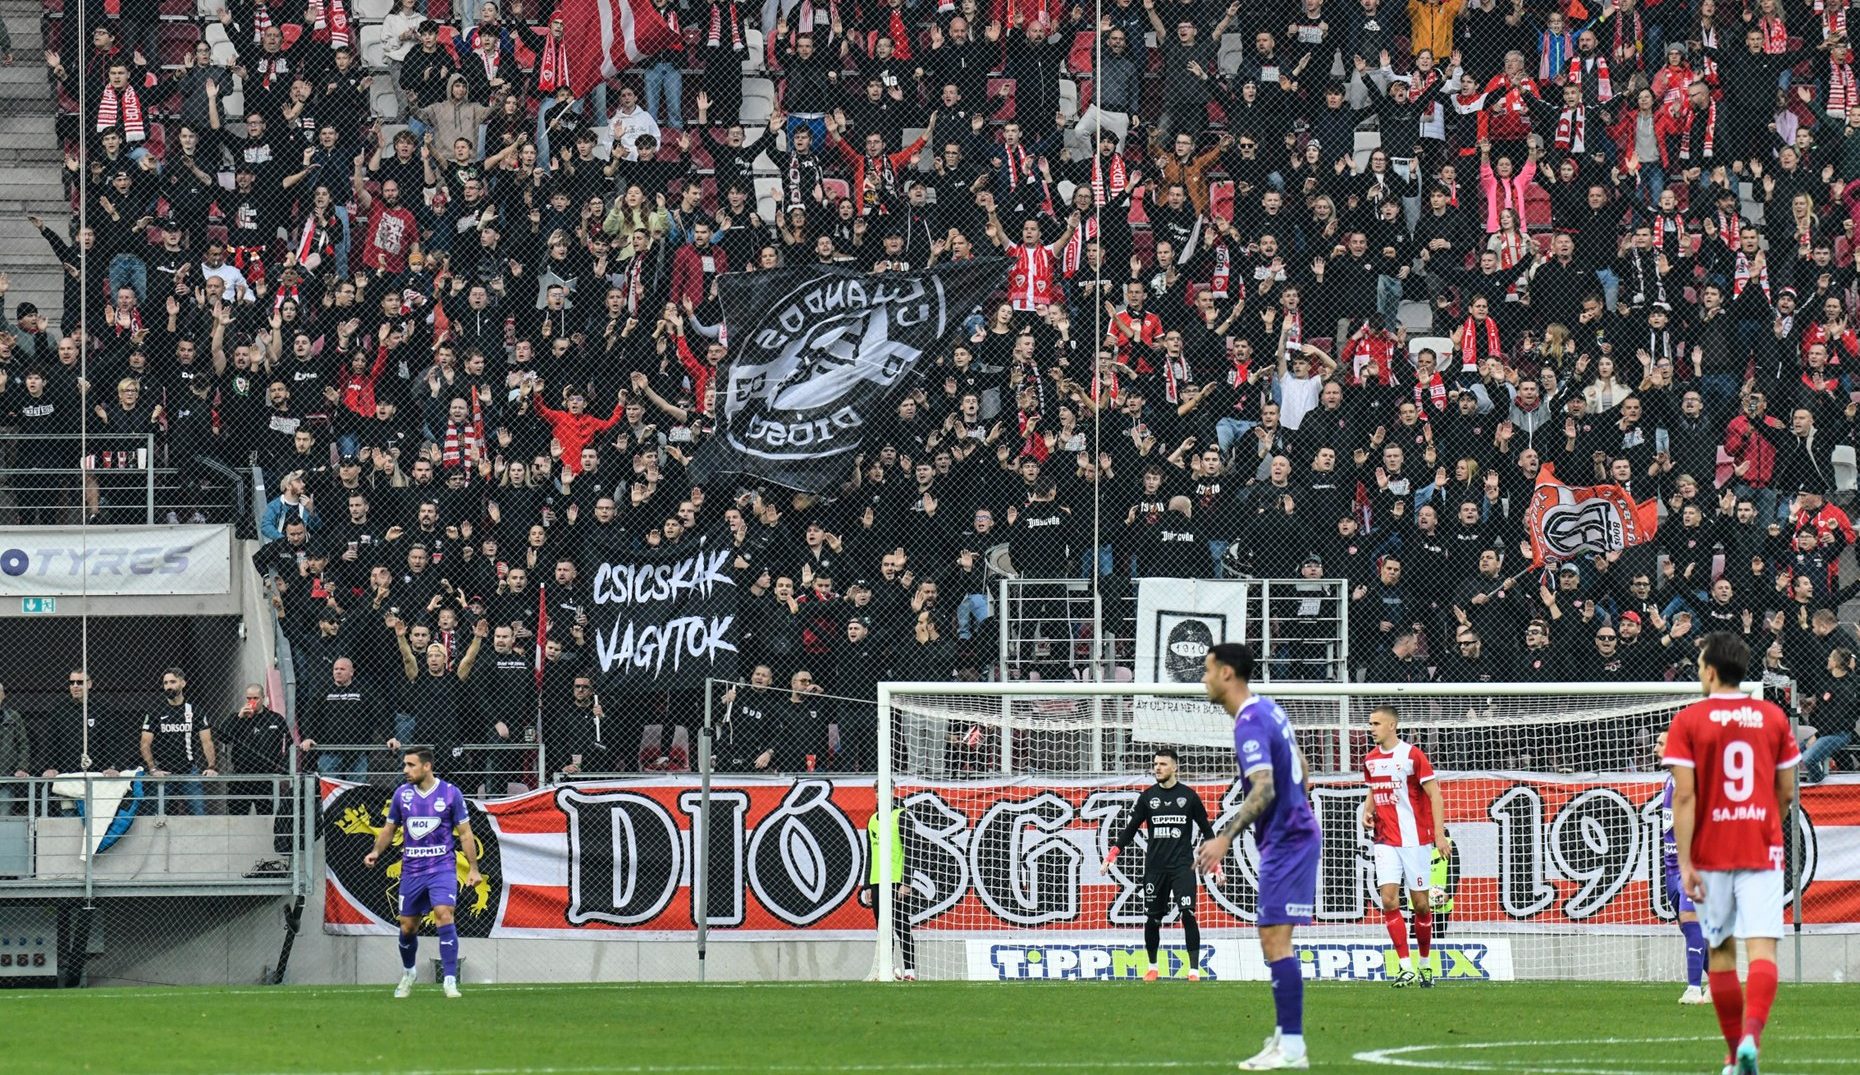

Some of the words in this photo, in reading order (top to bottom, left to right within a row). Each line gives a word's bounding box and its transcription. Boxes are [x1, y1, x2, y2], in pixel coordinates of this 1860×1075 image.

[593, 534, 737, 607] CSICSKÁK
[595, 612, 739, 681] VAGYTOK
[1709, 706, 1764, 726] apollo
[1723, 740, 1755, 803] 9
[1712, 803, 1767, 822] SAJBÁN
[412, 821, 428, 829] MOL
[1417, 877, 1423, 887] 6
[1181, 896, 1191, 906] 30
